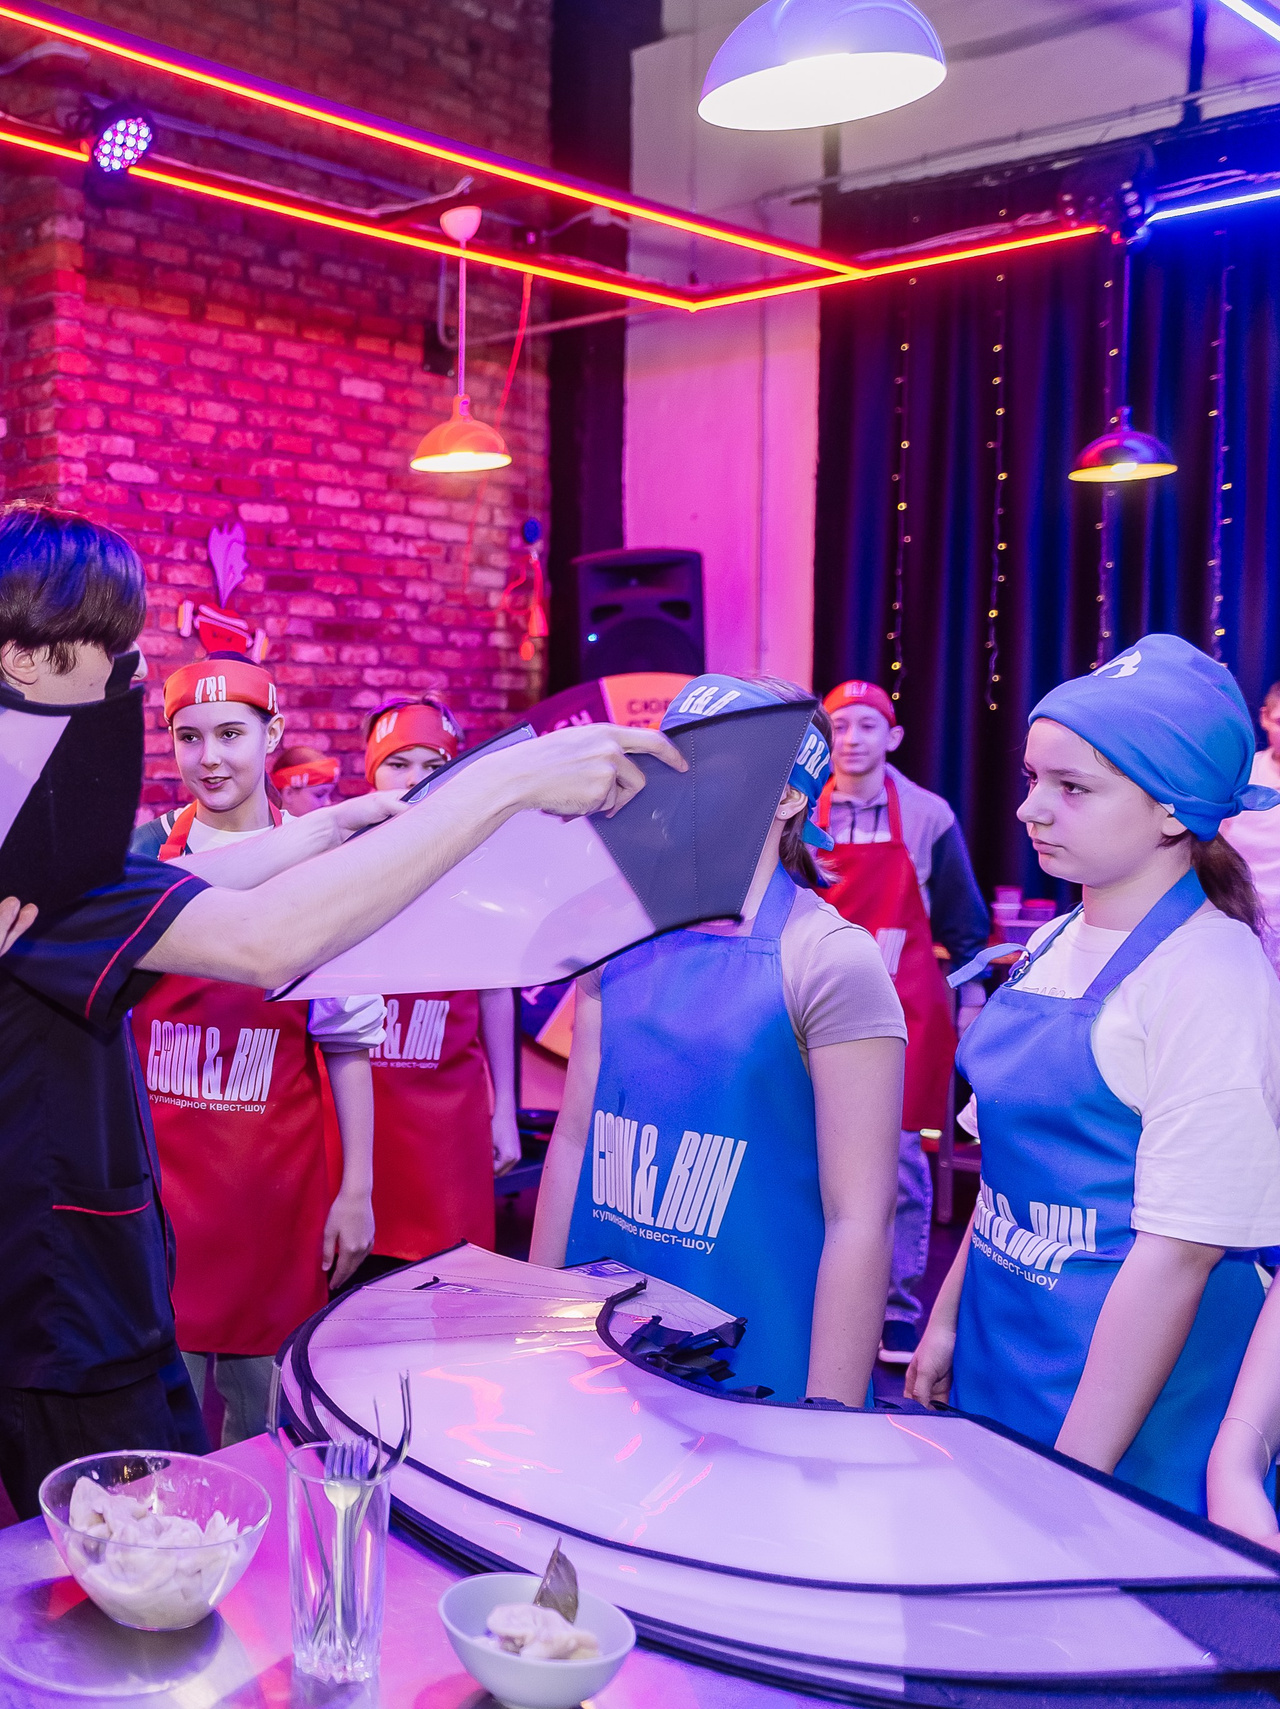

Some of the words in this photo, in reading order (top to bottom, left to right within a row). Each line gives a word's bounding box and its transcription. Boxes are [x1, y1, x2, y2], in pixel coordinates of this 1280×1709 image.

[402, 999, 450, 1060] RUN
[147, 1019, 202, 1098] COOK
[202, 1026, 223, 1100] &
[224, 1028, 280, 1101] RUN
[149, 1093, 207, 1110] кулинарное
[209, 1103, 266, 1114] квест-шоу
[592, 1110, 638, 1219] COOK
[633, 1124, 658, 1226] &
[655, 1130, 748, 1238] RUN
[592, 1208, 638, 1236] кулинарное
[639, 1227, 715, 1255] квест-шоу
[992, 1249, 1058, 1291] квест-шоу
